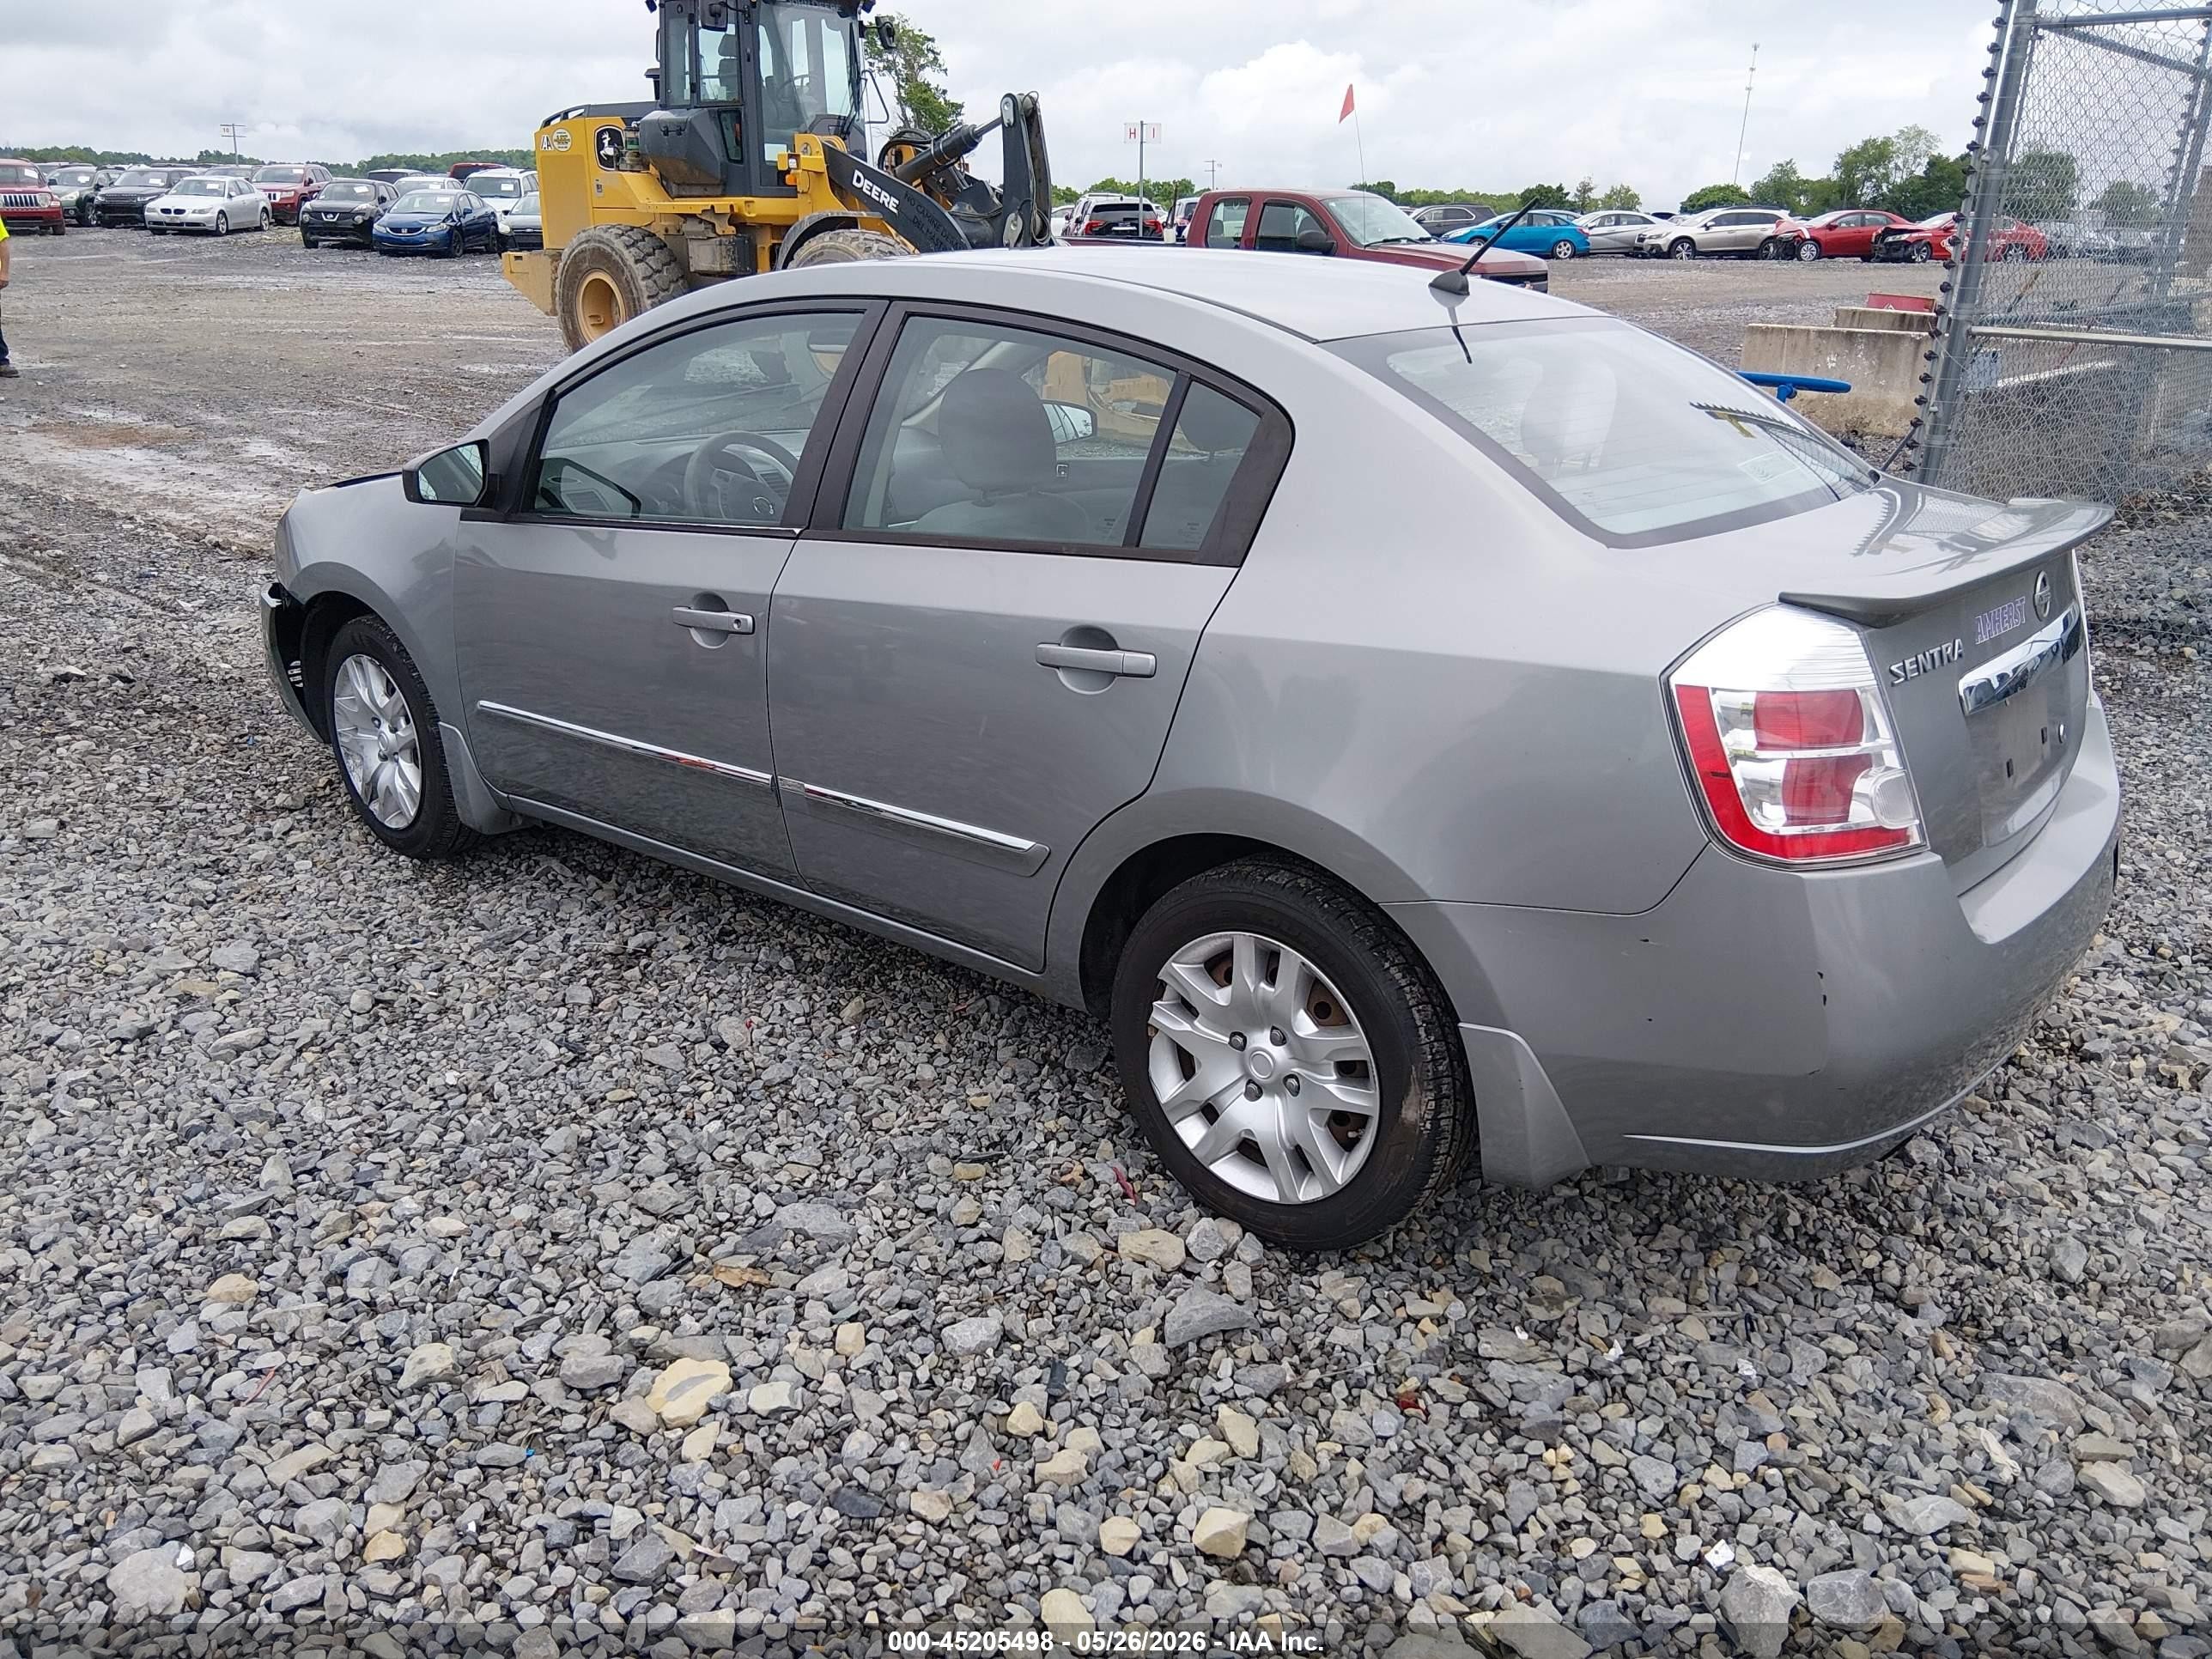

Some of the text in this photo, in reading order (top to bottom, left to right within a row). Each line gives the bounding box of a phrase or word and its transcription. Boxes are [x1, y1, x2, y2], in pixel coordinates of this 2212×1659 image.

[852, 169, 900, 214] DEERE
[1975, 597, 2026, 645] AMHERST
[1889, 638, 1964, 686] SENTRA
